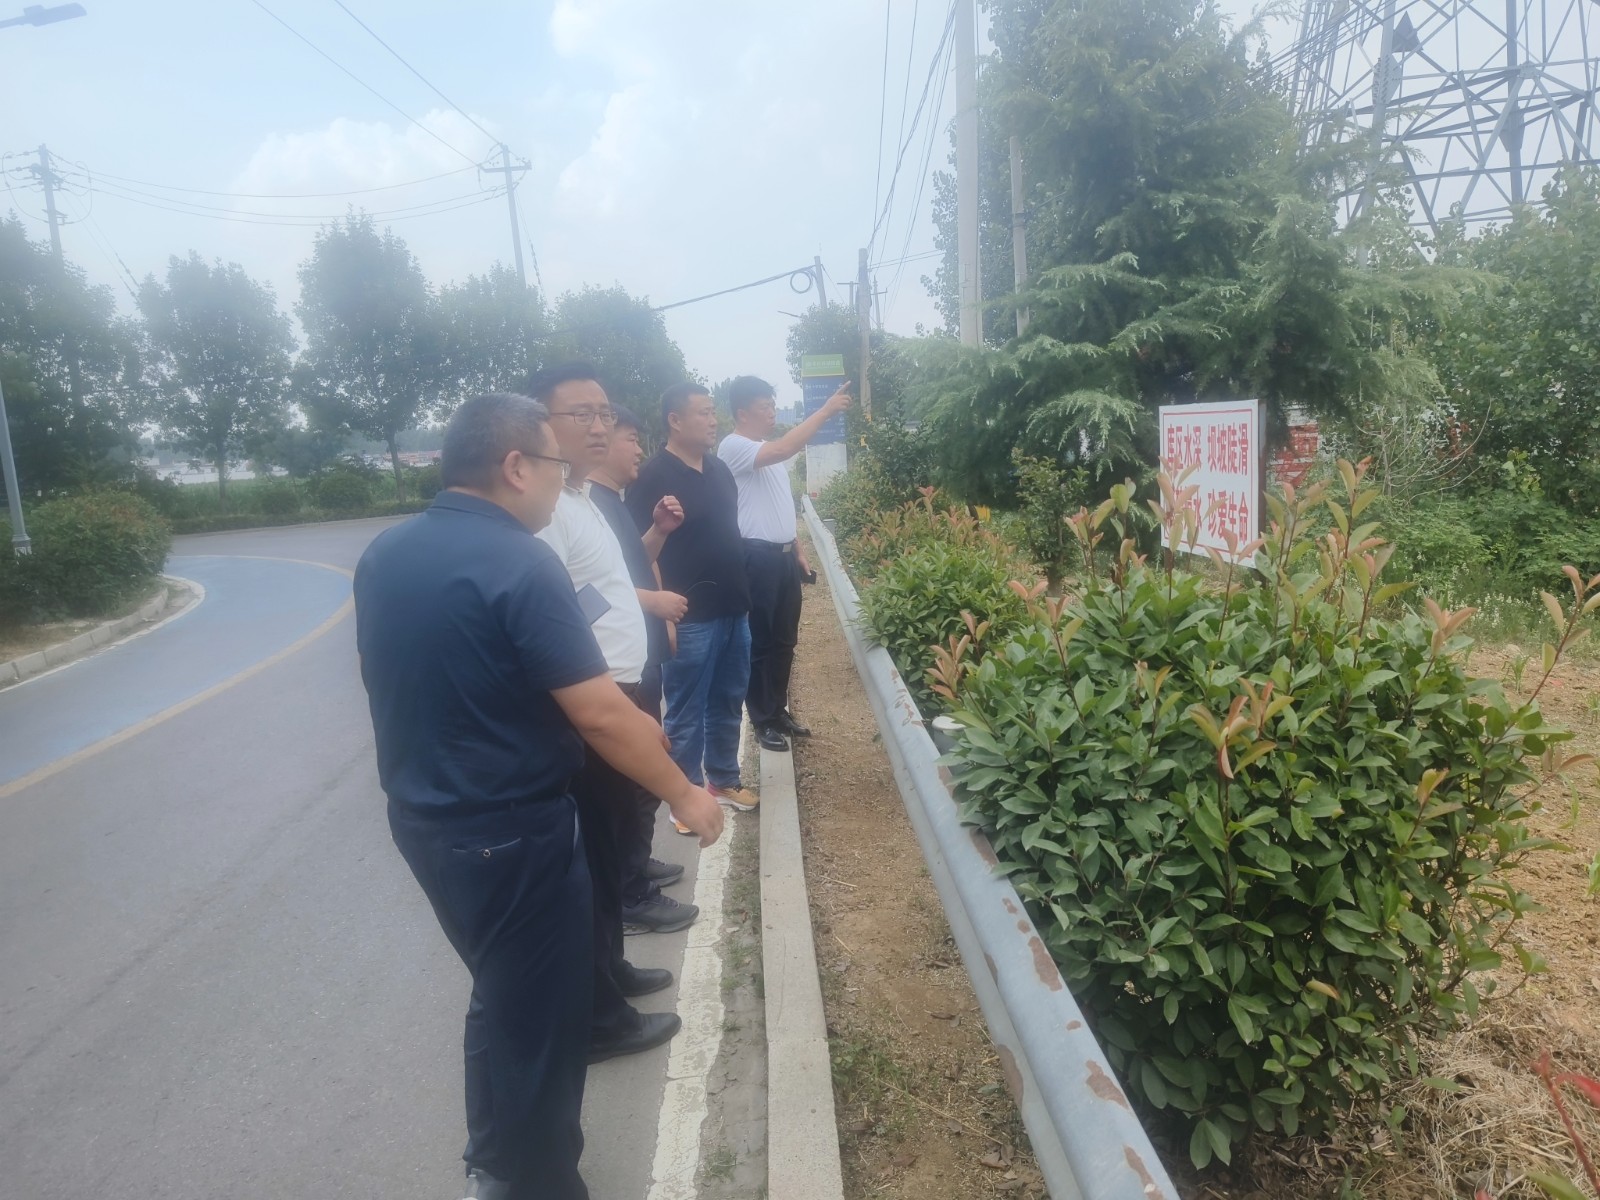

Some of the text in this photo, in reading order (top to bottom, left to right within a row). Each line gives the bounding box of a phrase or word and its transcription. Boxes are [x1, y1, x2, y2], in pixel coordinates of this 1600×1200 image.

[1168, 423, 1202, 472] 库区水深
[1207, 422, 1249, 476] 坝坡陡滑
[1208, 488, 1249, 545] 珍爱生命
